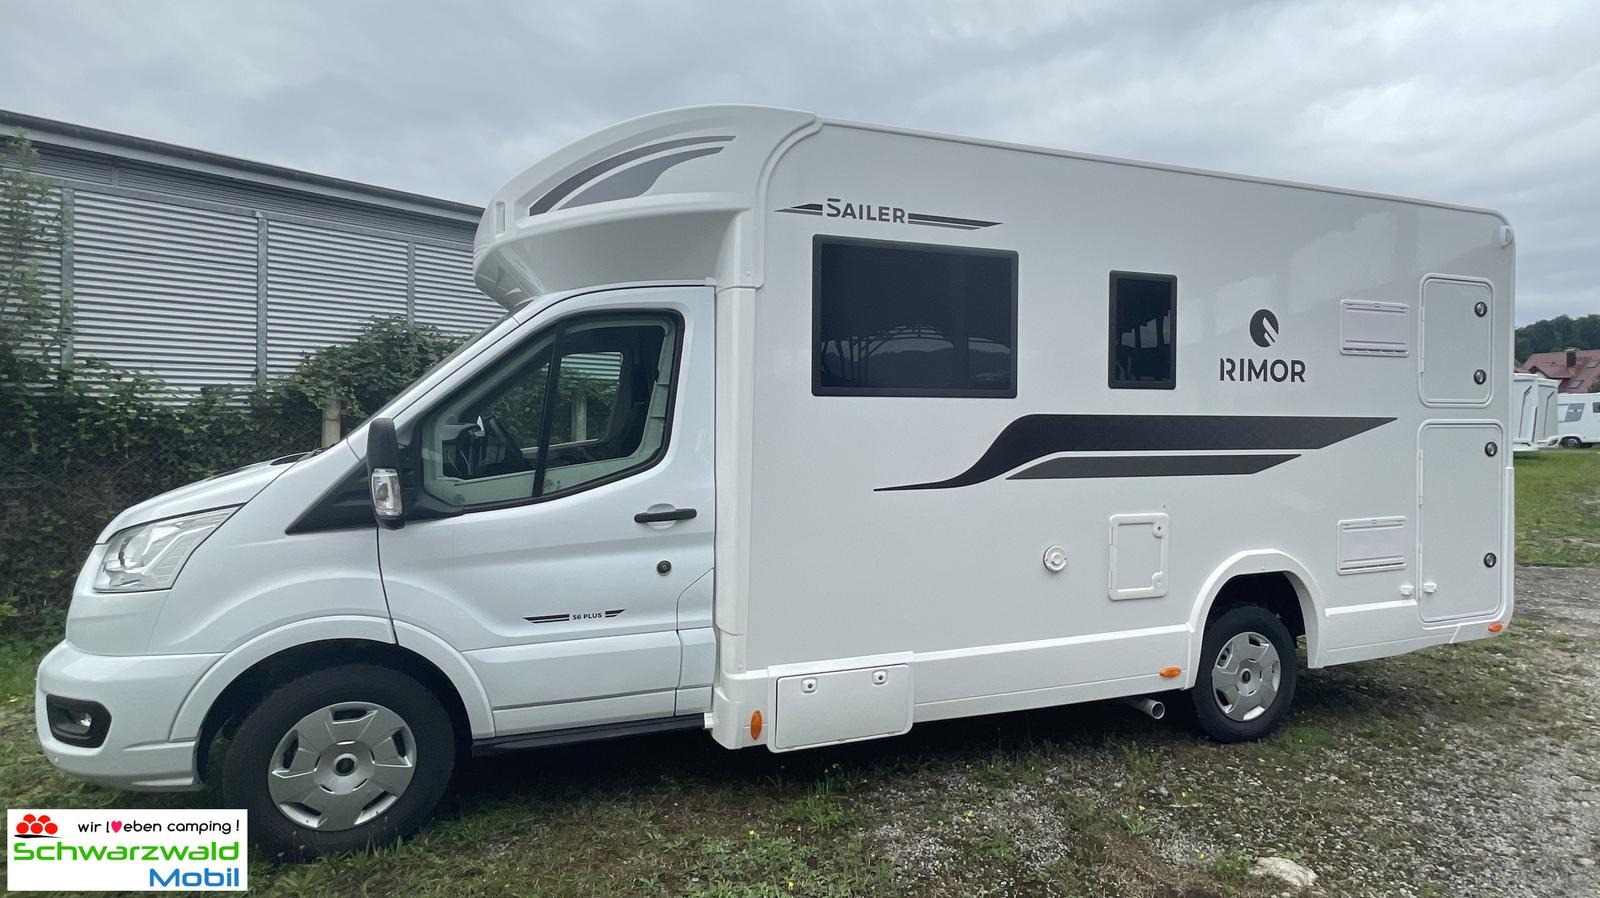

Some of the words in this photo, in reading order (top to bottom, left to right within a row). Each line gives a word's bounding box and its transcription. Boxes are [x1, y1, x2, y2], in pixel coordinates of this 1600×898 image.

[826, 197, 906, 224] SAILER
[1219, 357, 1306, 383] RIMOR
[583, 612, 603, 620] PLUS
